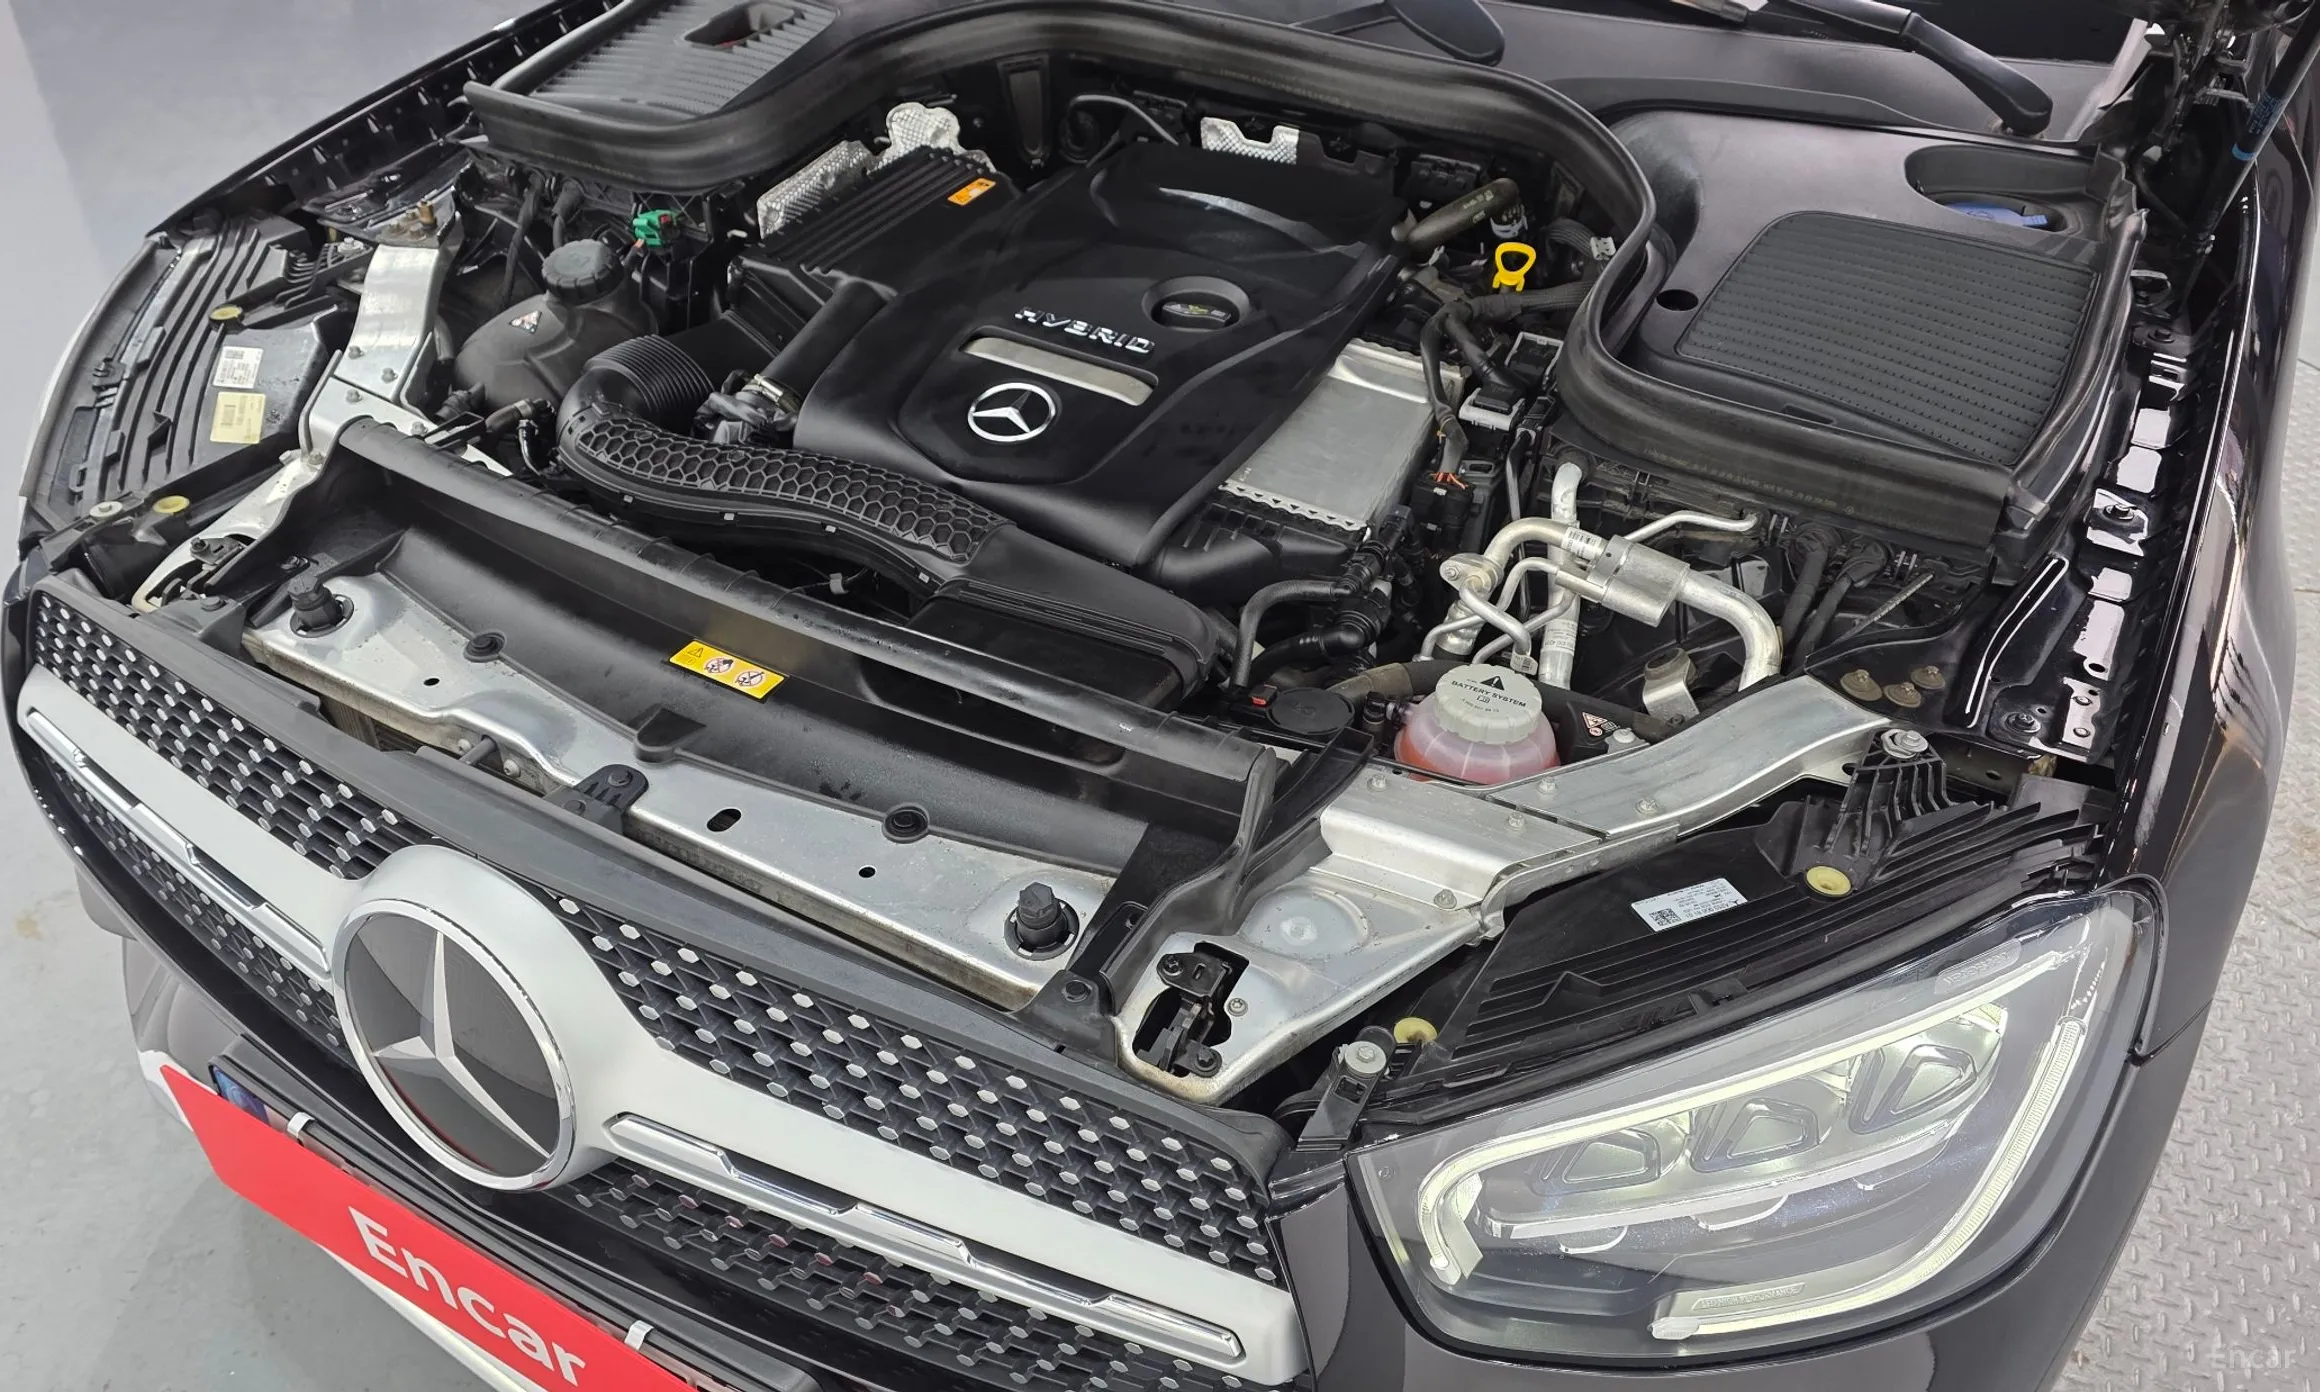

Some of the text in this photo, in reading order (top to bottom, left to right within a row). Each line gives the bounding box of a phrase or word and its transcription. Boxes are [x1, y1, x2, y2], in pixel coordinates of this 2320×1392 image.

[1014, 307, 1156, 354] HYBRID
[1451, 680, 1491, 696] BATTERY
[1491, 692, 1527, 708] SYSTEM
[348, 1206, 587, 1388] Encar
